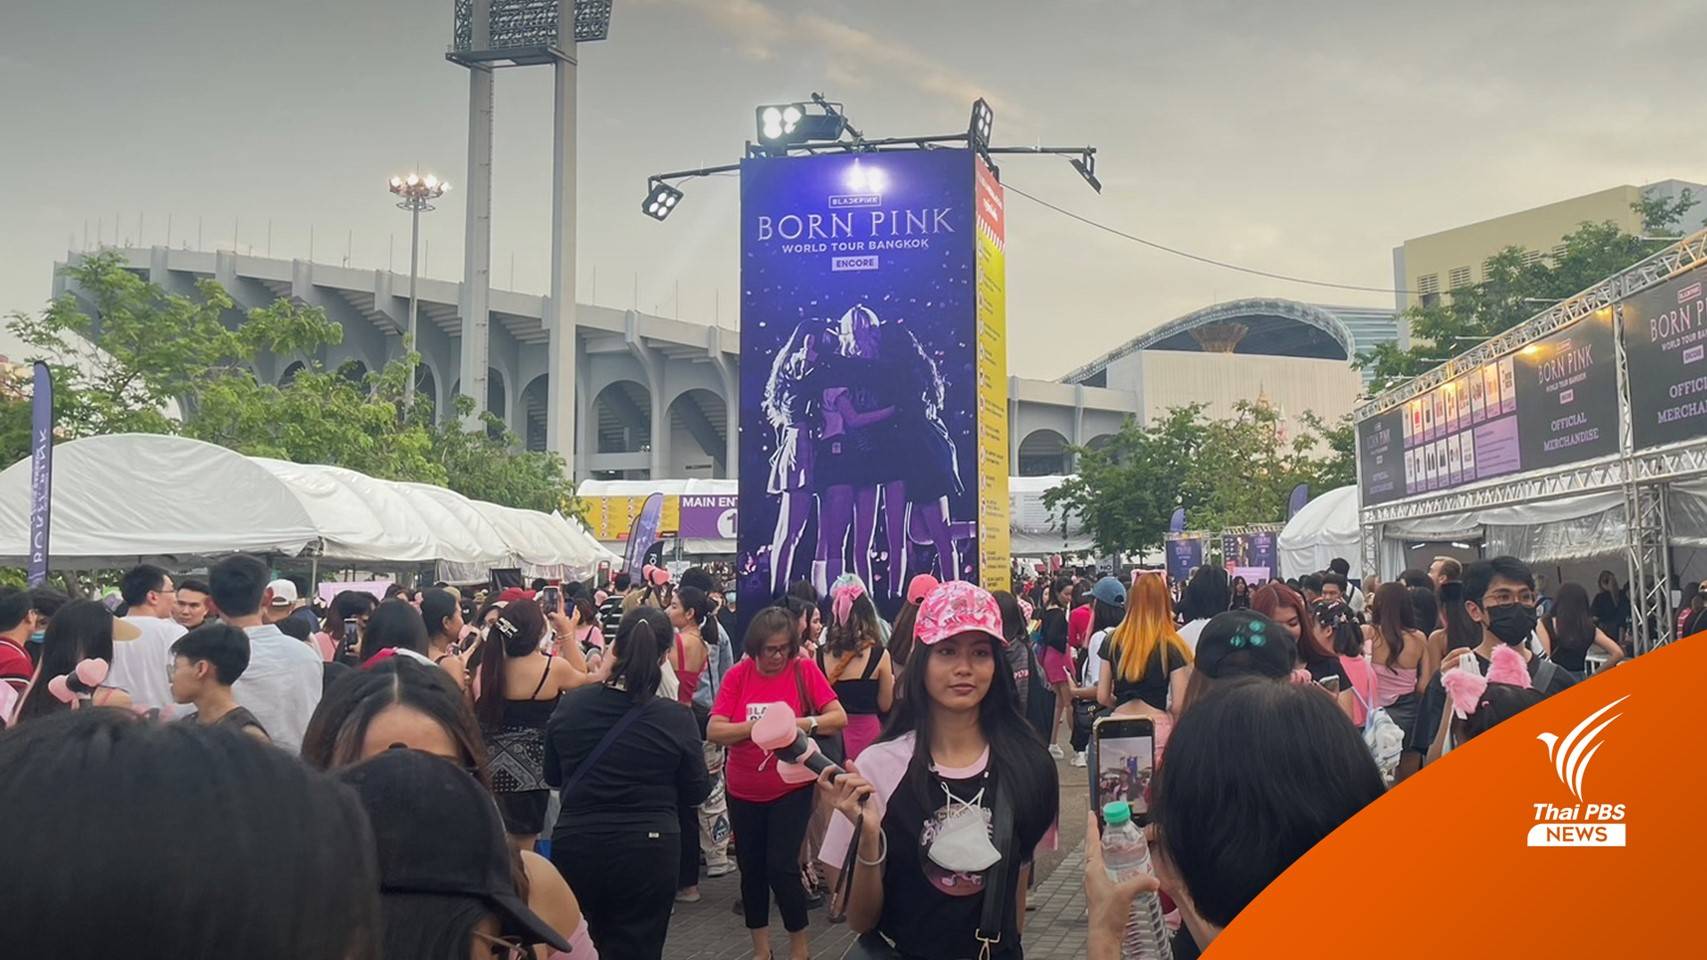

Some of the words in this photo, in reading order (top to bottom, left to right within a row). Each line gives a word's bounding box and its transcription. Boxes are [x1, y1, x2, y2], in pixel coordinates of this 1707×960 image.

[758, 212, 853, 241] BORN
[870, 207, 955, 236] PINK
[782, 243, 827, 254] WORLD
[831, 242, 864, 252] TOUR
[869, 239, 929, 250] BANGKOK
[836, 259, 875, 269] ENCORE
[1650, 304, 1691, 343] BORN
[1538, 355, 1565, 384] BORN
[1568, 344, 1593, 374] PINK
[1551, 412, 1587, 432] OFFICIAL
[1658, 400, 1707, 424] MERCHA
[1544, 427, 1599, 452] MERCHANDISE
[682, 497, 716, 508] MAIN
[719, 496, 738, 508] EN
[727, 513, 737, 534] 1
